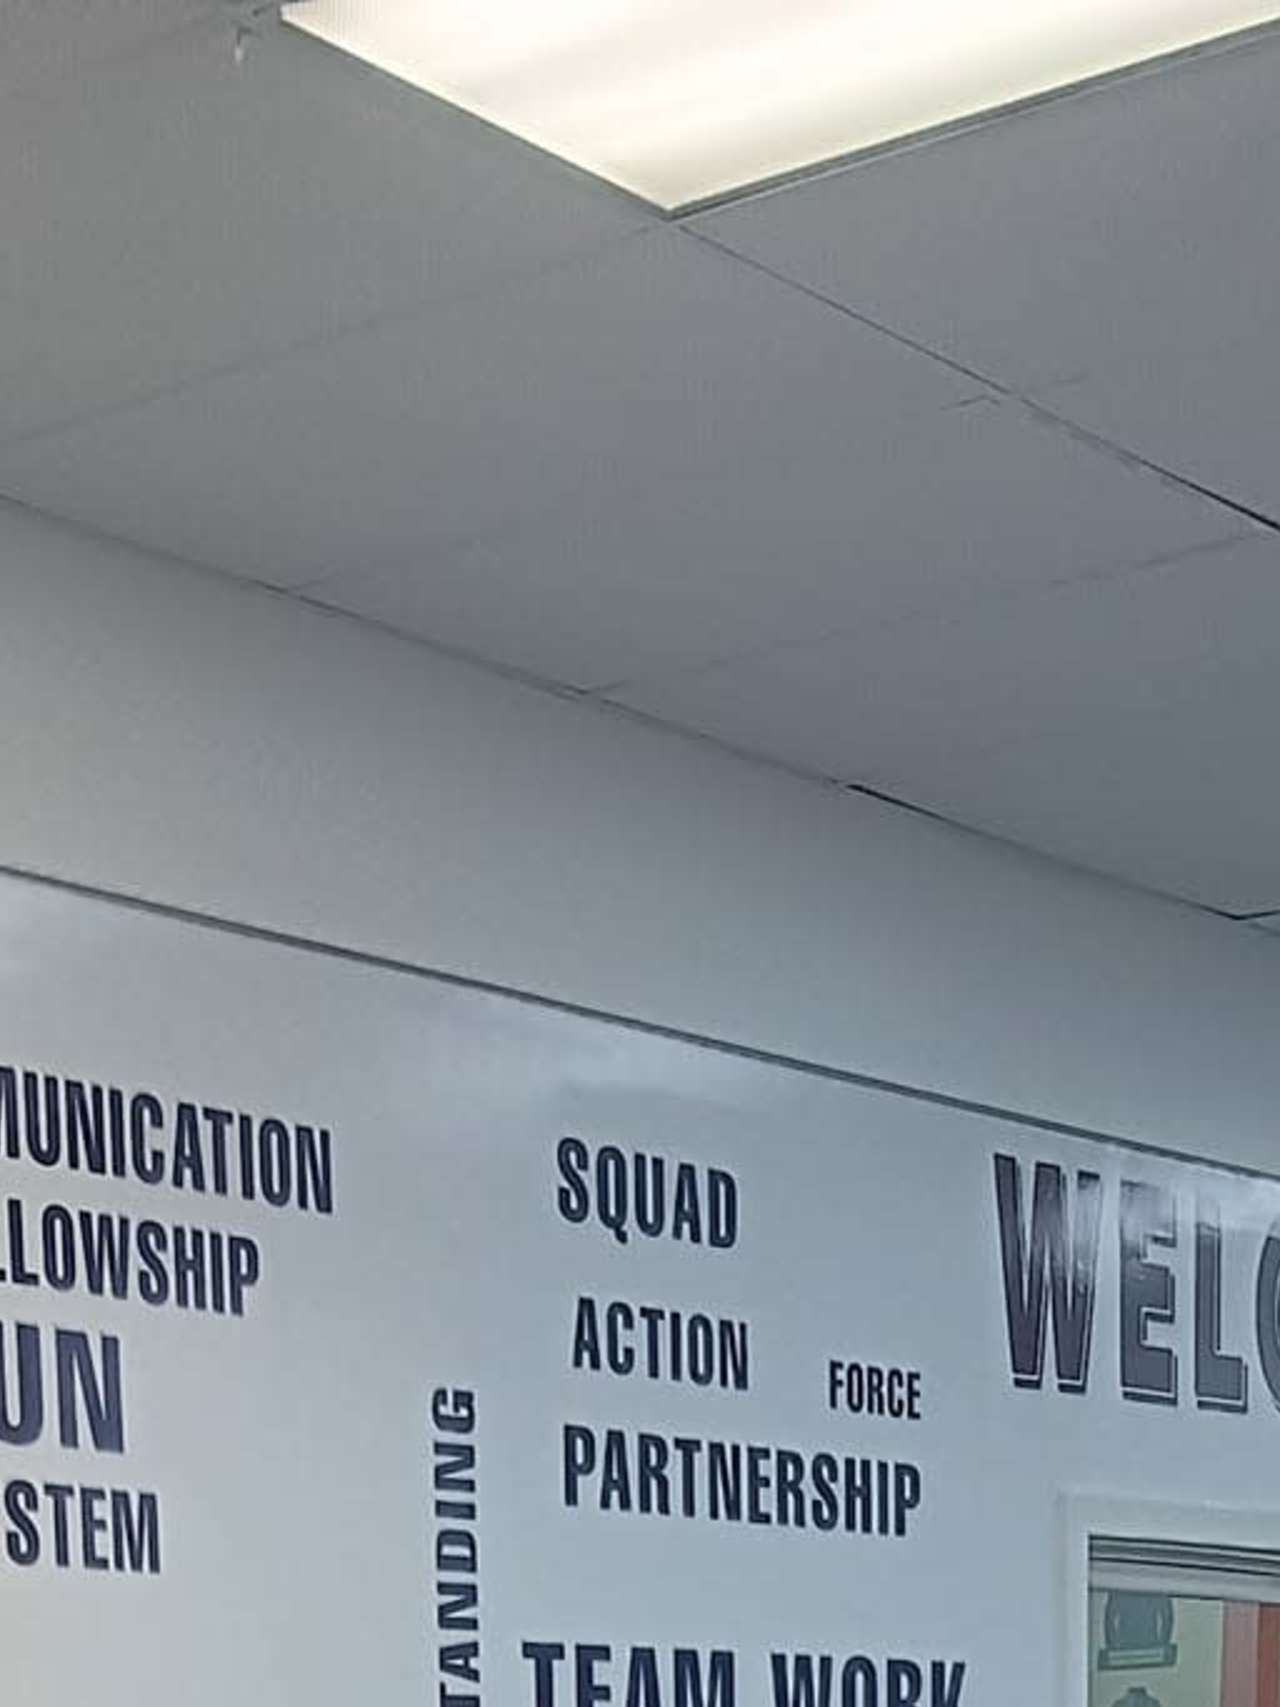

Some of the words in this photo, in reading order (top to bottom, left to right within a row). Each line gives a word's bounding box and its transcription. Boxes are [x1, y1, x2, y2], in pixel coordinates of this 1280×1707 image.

[557, 1137, 738, 1249] SQUAD
[572, 1296, 750, 1391] ACTION
[829, 1359, 922, 1421] FORCE
[563, 1424, 921, 1537] PARTNERSHIP
